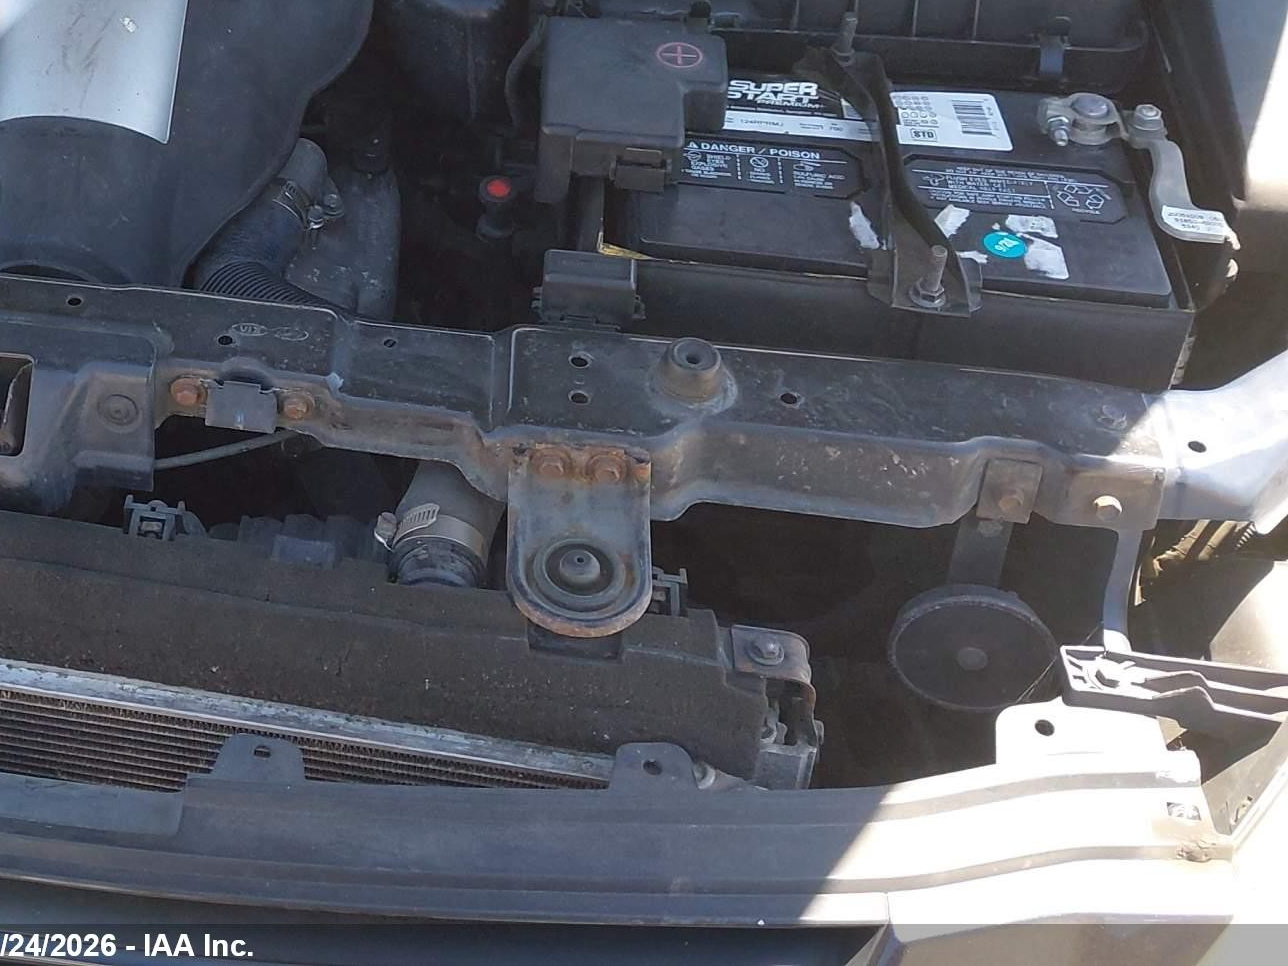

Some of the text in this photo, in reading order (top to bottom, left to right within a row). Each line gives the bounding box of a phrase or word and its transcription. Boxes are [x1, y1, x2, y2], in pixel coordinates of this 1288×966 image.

[729, 80, 819, 96] SUPER
[727, 90, 820, 103] START
[913, 130, 934, 139] STD
[701, 142, 756, 154] DANGER
[769, 148, 820, 160] POISON
